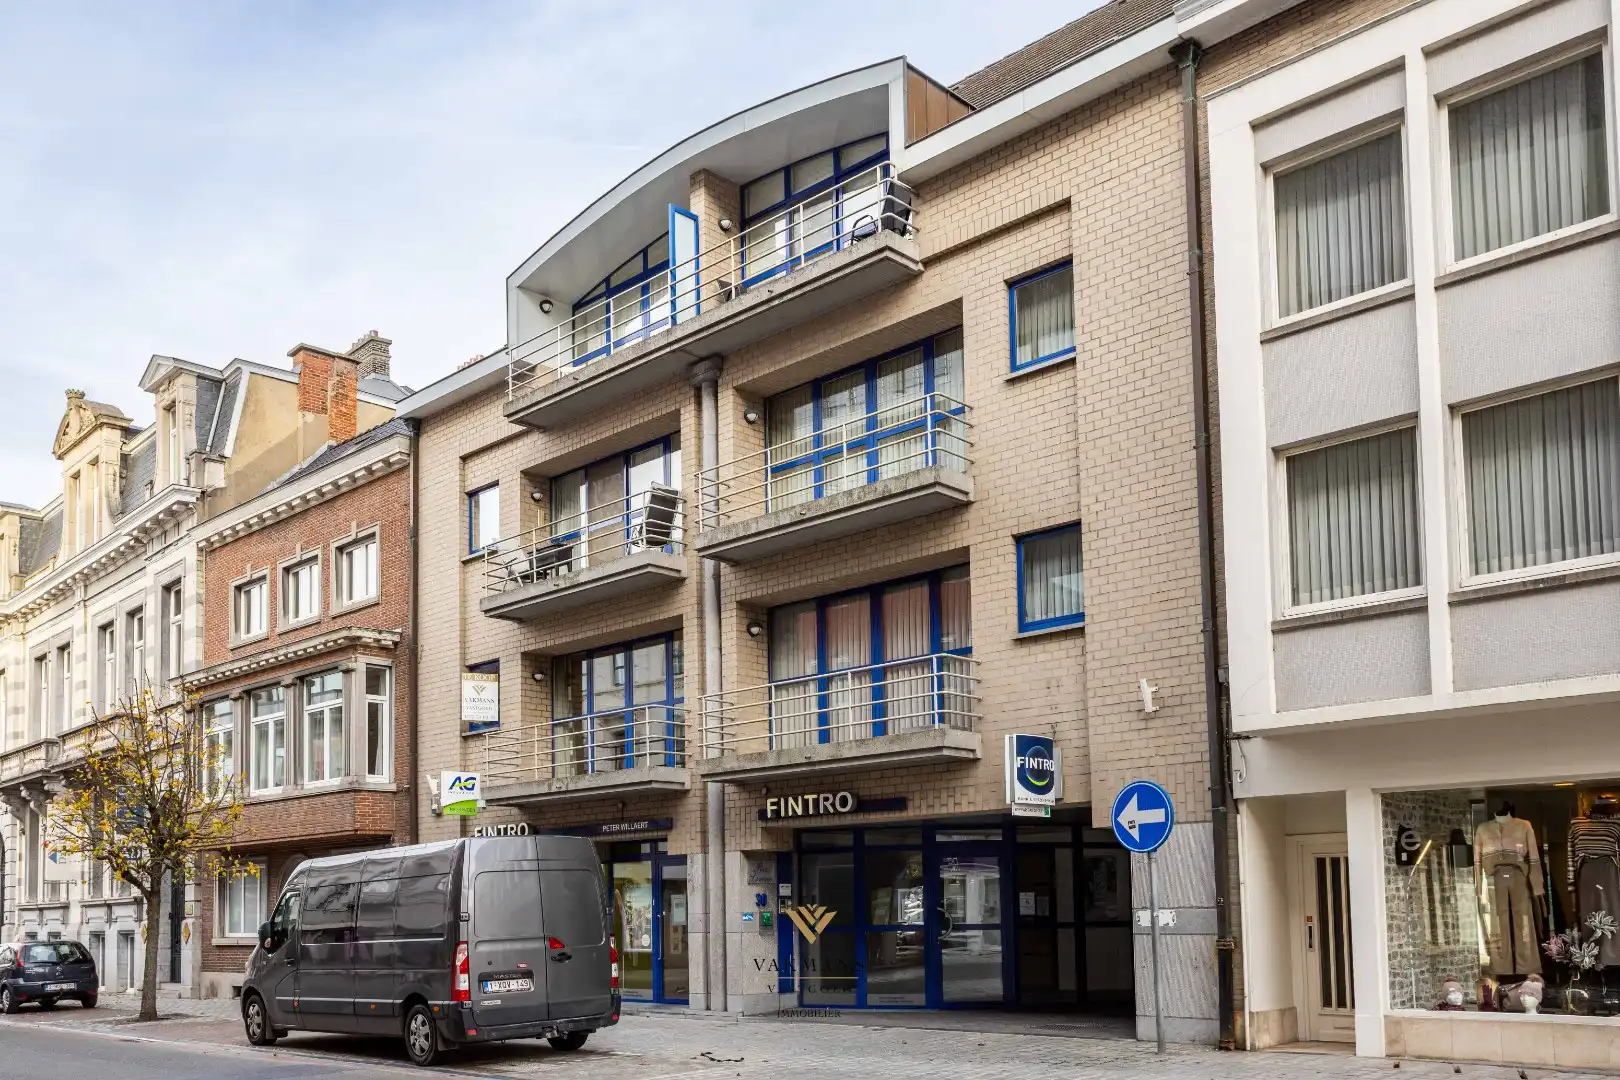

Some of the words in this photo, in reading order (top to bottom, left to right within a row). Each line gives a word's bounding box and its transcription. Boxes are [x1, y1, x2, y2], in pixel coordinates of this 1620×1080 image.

[474, 674, 497, 682] KOOP
[1016, 756, 1055, 771] FINTRO
[448, 776, 477, 791] AG
[766, 791, 854, 819] FINTRO
[474, 822, 529, 837] FINTRO
[602, 824, 620, 832] PETER
[620, 821, 649, 831] WILLAERT
